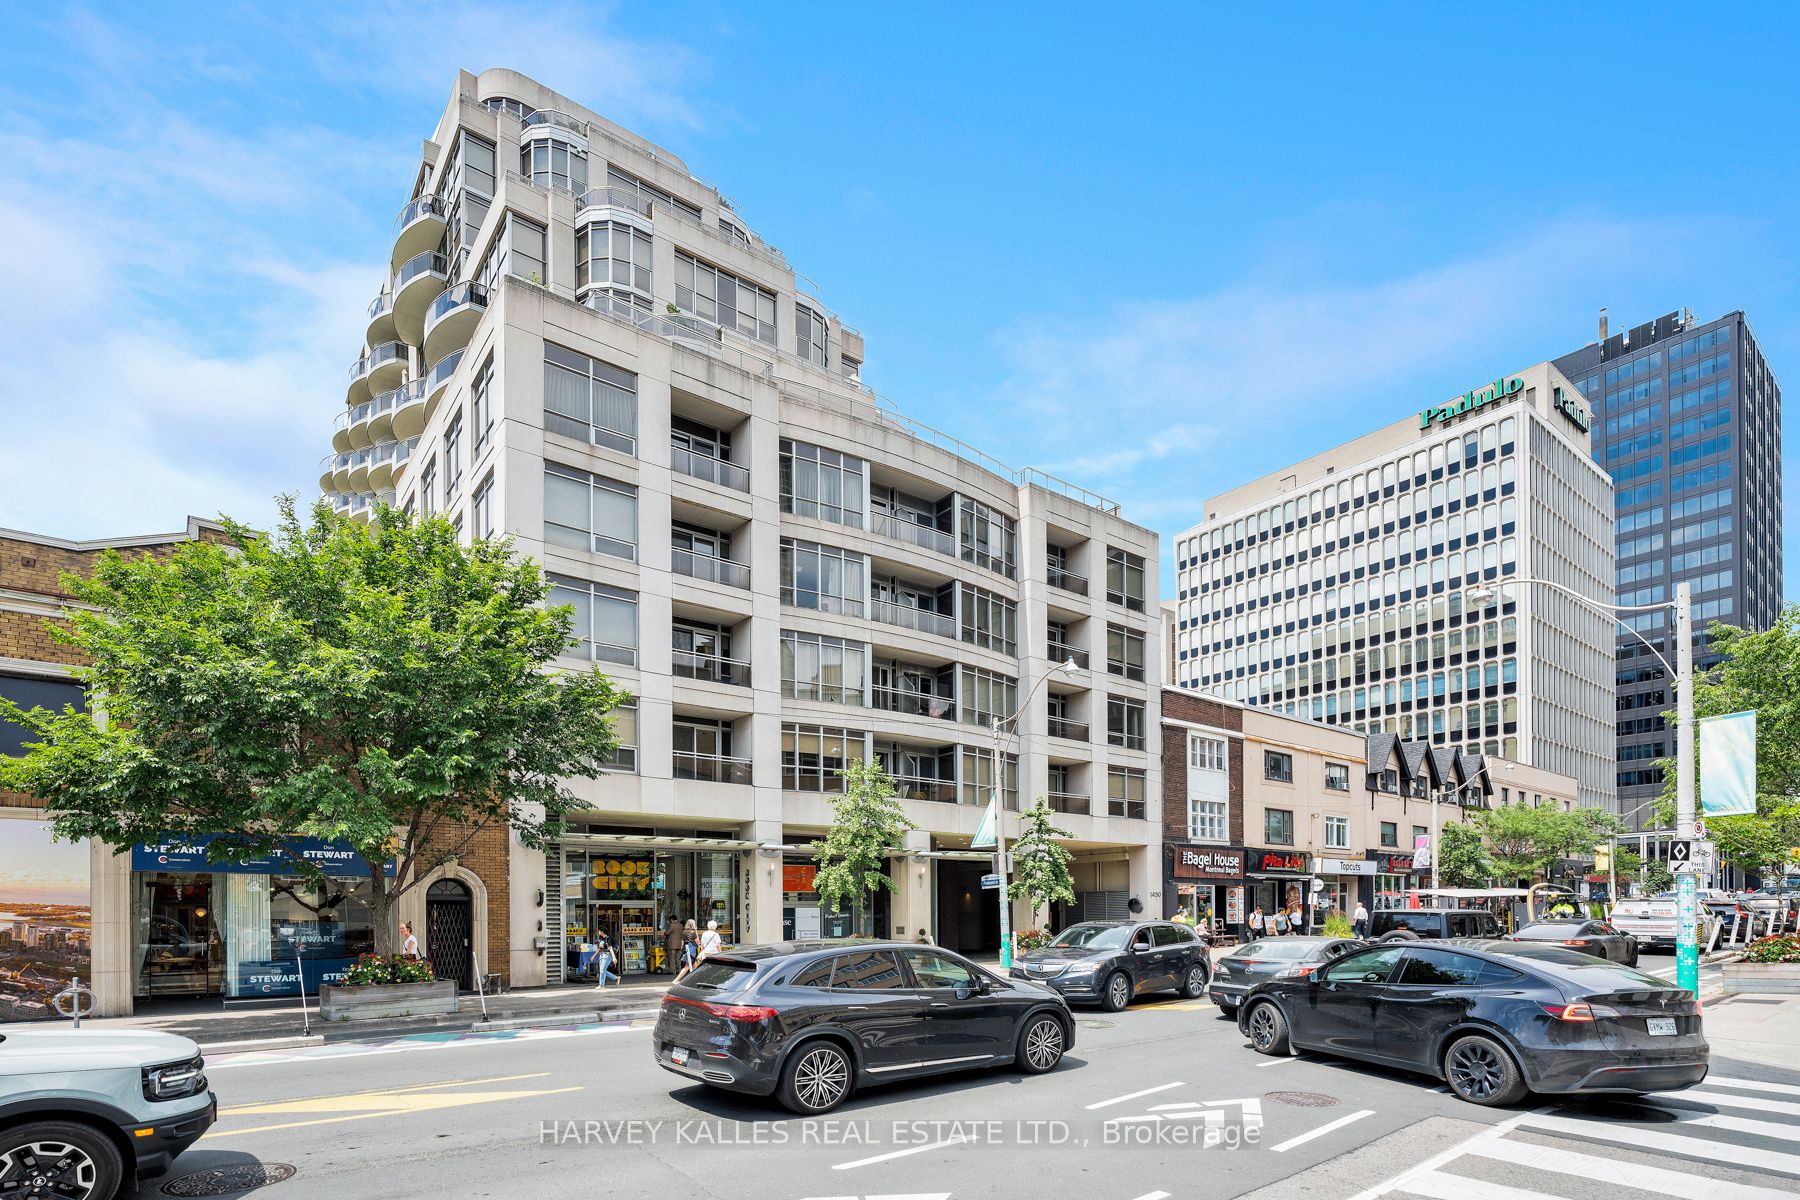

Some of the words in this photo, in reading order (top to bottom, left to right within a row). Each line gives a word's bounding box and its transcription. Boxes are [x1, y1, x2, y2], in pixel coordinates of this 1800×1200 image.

[1420, 377, 1525, 429] Padulo
[303, 850, 355, 859] STEWART
[1187, 851, 1212, 869] Bagel
[1214, 853, 1240, 867] House
[592, 860, 650, 876] BOOK
[1225, 867, 1240, 876] Bagels
[1339, 861, 1361, 873] Topcuts
[591, 875, 650, 892] CITY
[250, 975, 303, 983] STEWART
